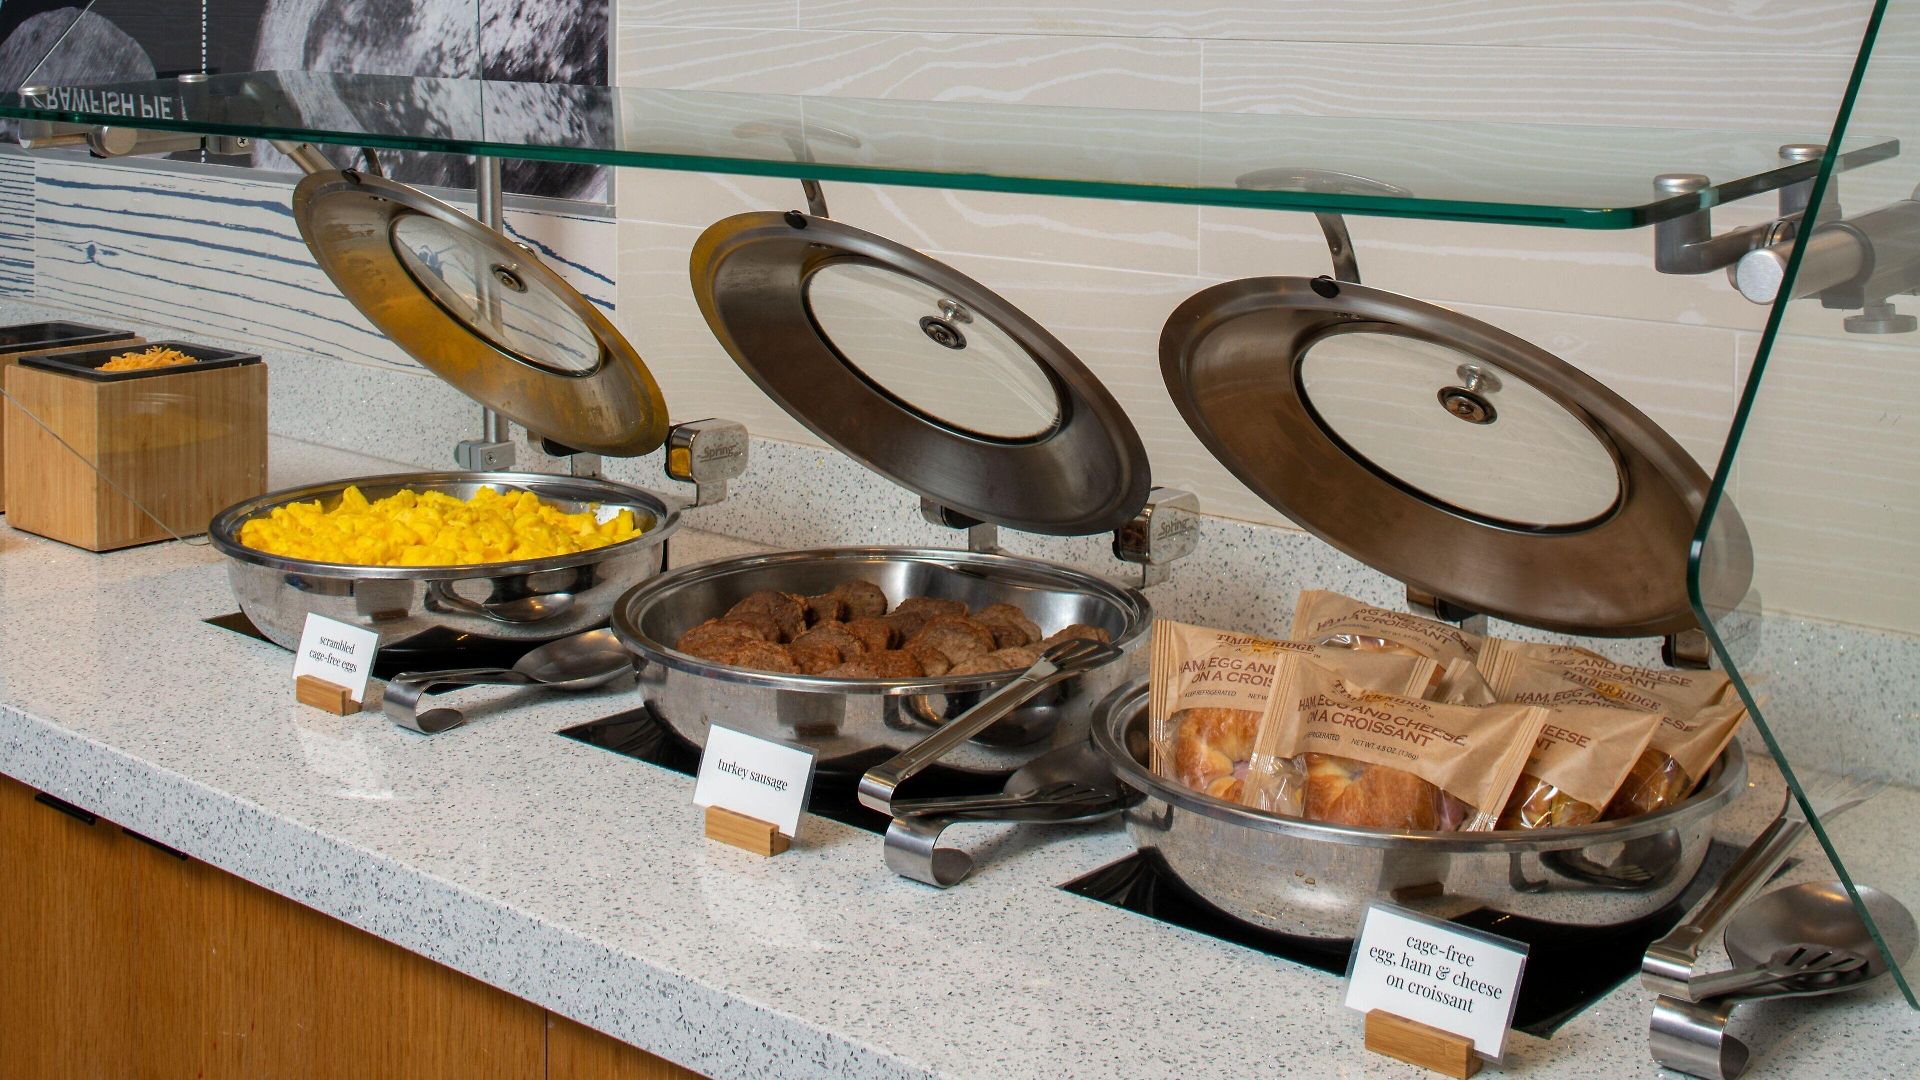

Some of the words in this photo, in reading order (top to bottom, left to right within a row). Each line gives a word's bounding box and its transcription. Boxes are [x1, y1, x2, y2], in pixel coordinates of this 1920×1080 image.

[320, 635, 356, 655] scrambled
[1362, 616, 1452, 644] CROISSANT
[309, 648, 341, 668] cage-free
[341, 660, 358, 673] eggs
[1208, 656, 1242, 670] EGG
[1578, 658, 1617, 671] AND
[1620, 664, 1694, 688] CHEESE
[1191, 670, 1211, 684] ON
[1212, 670, 1223, 681] A
[1562, 670, 1615, 695] TIMBER
[1616, 688, 1662, 711] RIDGE
[1514, 691, 1551, 704] HAM,
[1554, 688, 1584, 701] EGG
[1318, 709, 1329, 722] A
[1332, 711, 1434, 748] CROISSANT
[1350, 706, 1392, 721] AND
[1394, 716, 1468, 747] CHEESE
[1351, 738, 1364, 747] NET
[717, 758, 749, 780] turkey
[749, 770, 788, 792] sausage
[1406, 935, 1475, 967] cage-free
[1369, 945, 1397, 966] egg,
[1400, 952, 1432, 977] ham
[1435, 964, 1451, 981] &
[1452, 970, 1503, 1000] cheese
[1386, 972, 1404, 989] on
[1407, 980, 1475, 1014] croissant
